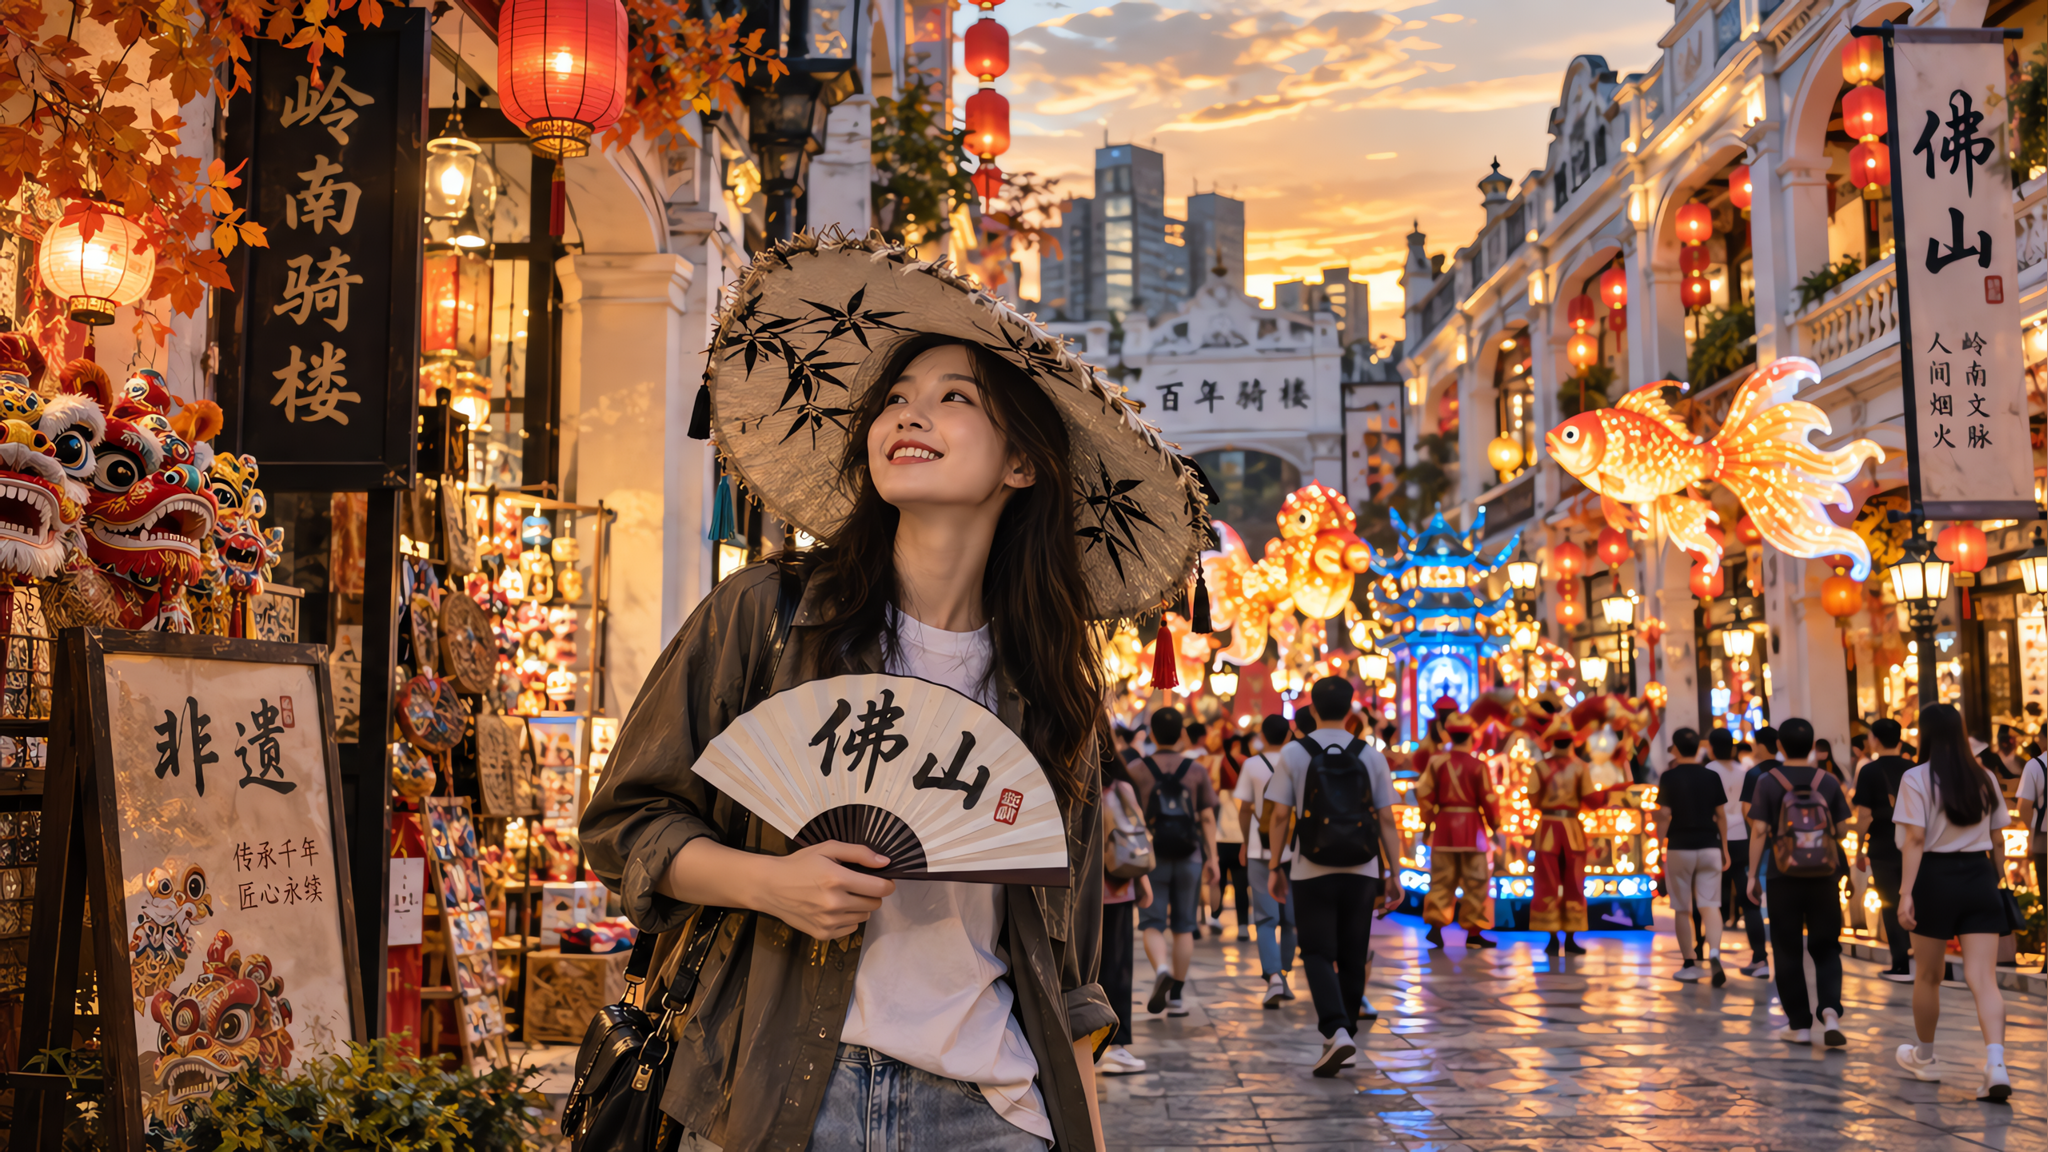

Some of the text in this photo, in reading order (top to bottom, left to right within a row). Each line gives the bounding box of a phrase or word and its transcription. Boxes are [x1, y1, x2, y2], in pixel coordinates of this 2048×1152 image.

[1912, 89, 1996, 275] 佛山
[271, 66, 375, 426] 岭南骑楼
[1155, 377, 1312, 414] 百年骑楼
[1927, 331, 1957, 450] 人间烟火
[1962, 331, 1994, 450] 岭南文脉
[154, 696, 298, 798] 非遗
[808, 688, 991, 811] 佛山
[233, 836, 319, 873] 传承千年
[238, 874, 323, 911] 匠心永续
